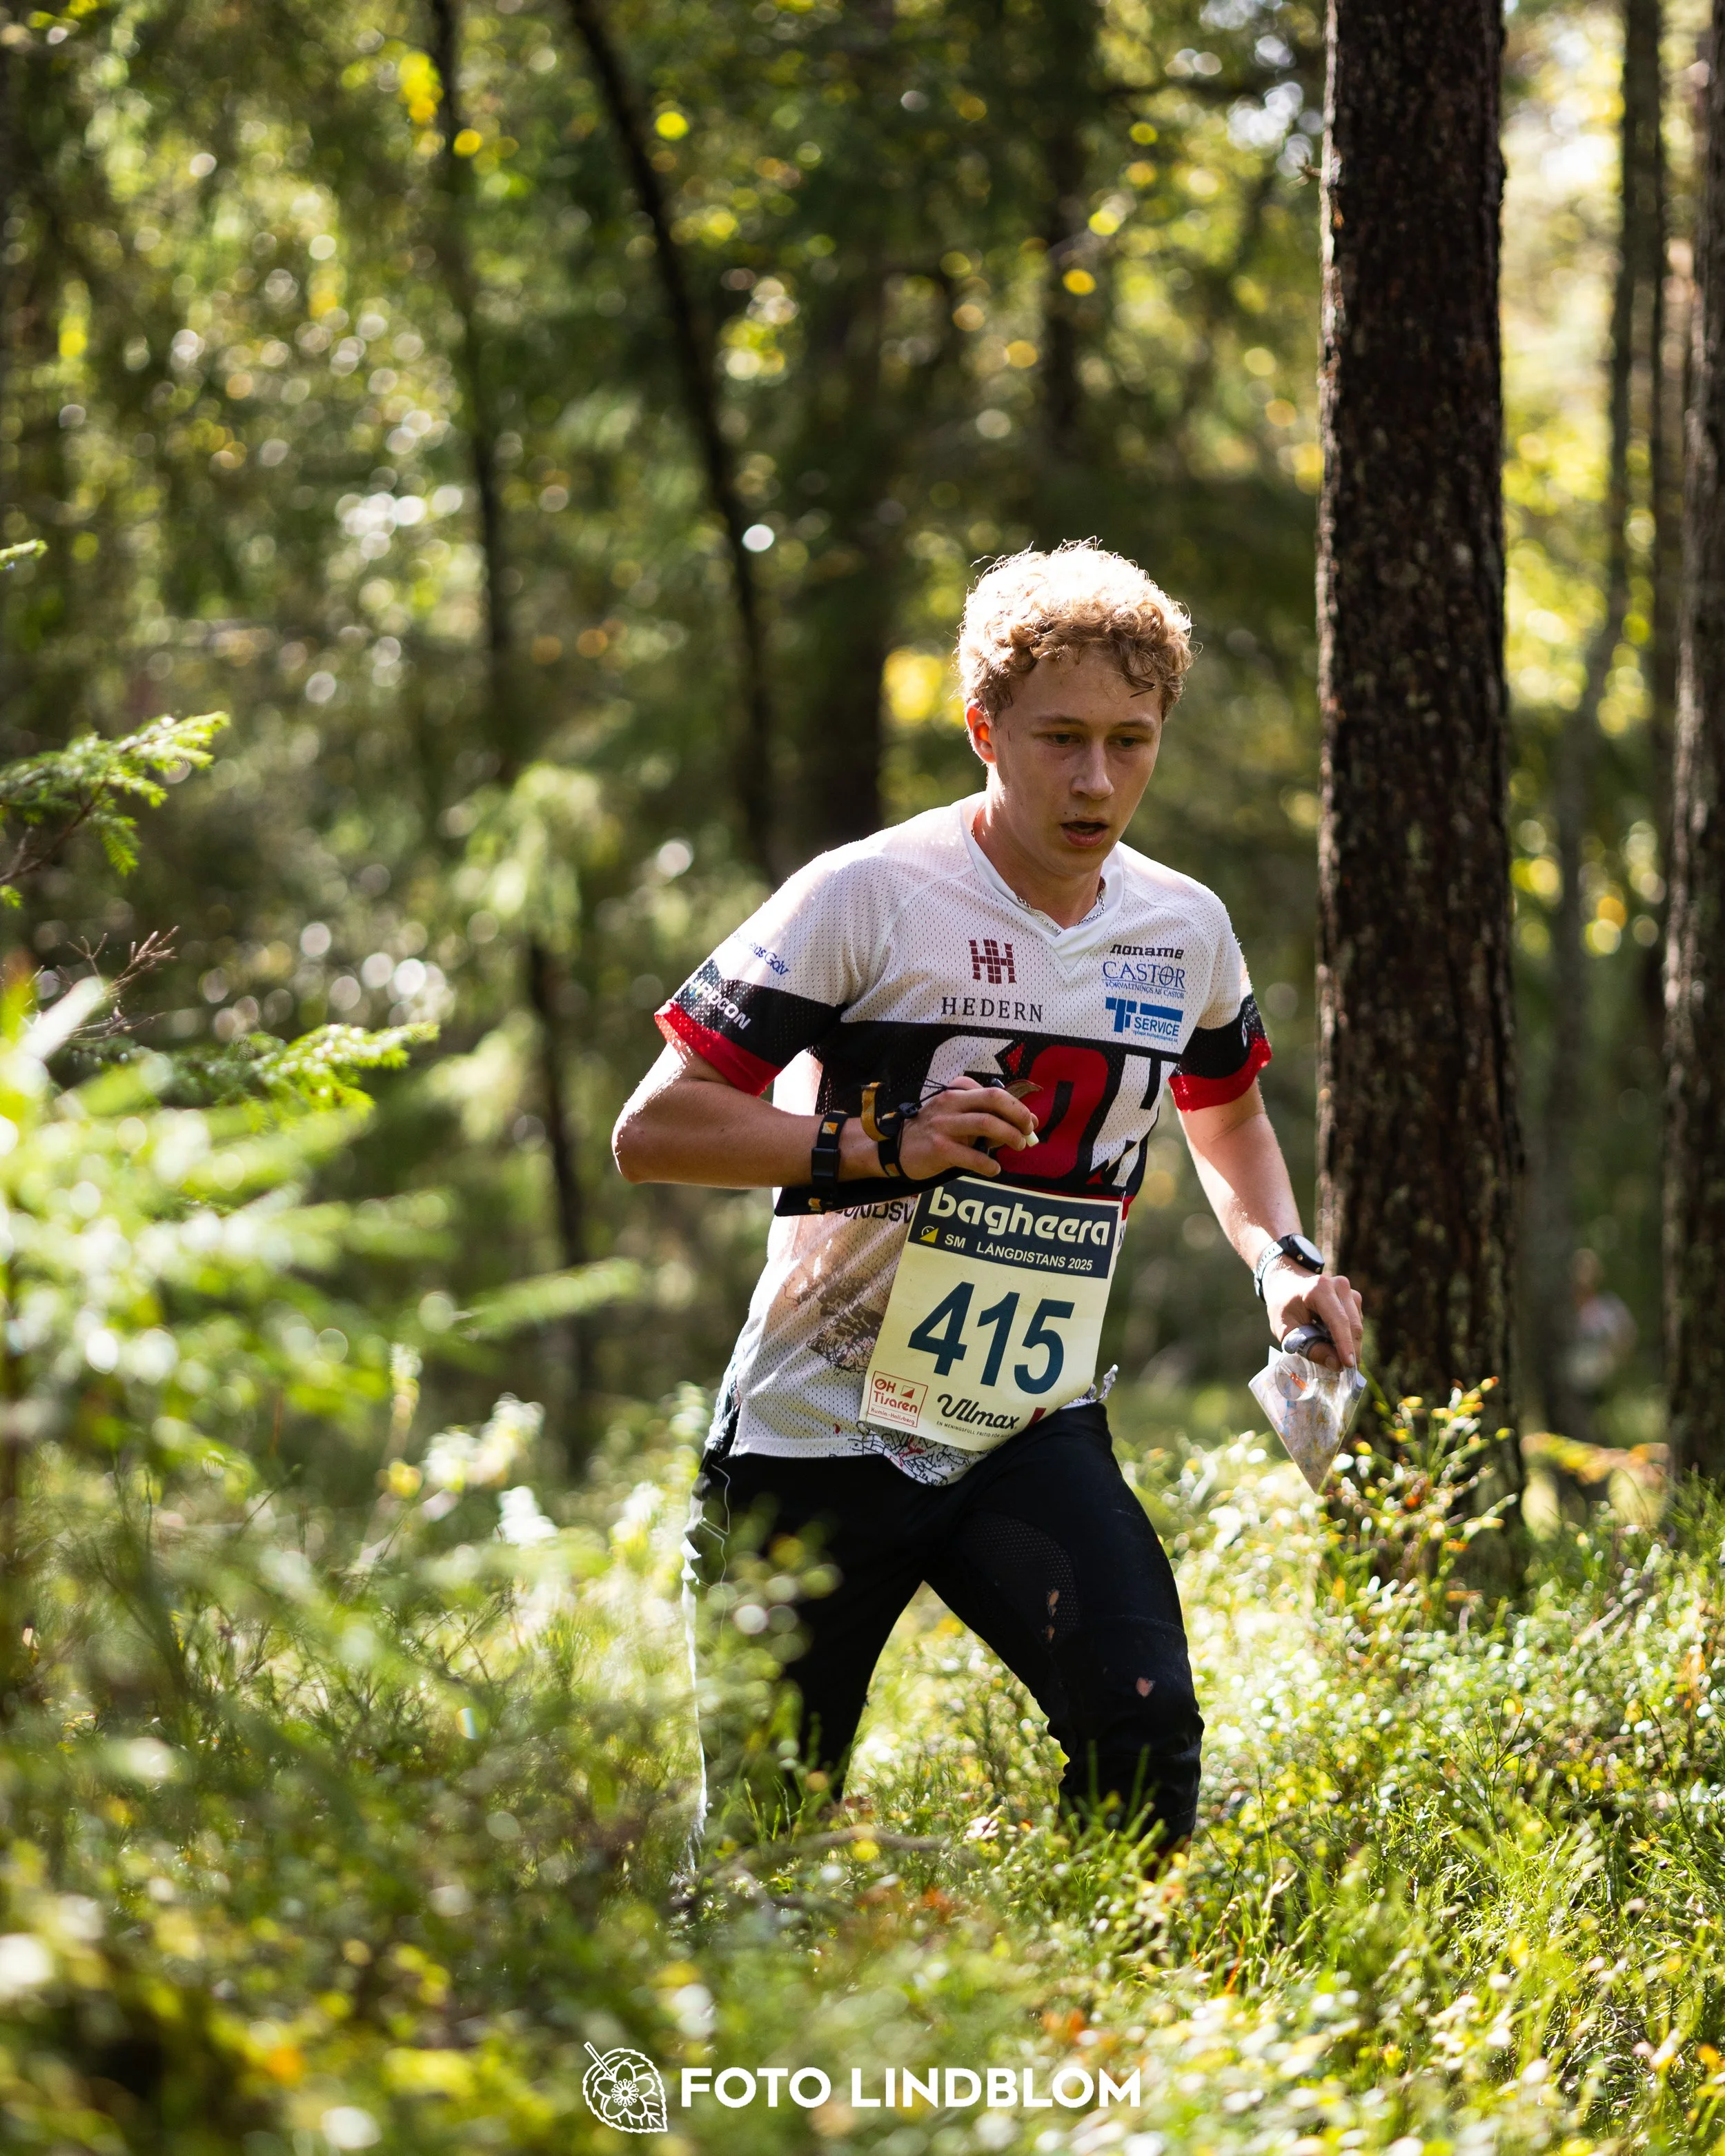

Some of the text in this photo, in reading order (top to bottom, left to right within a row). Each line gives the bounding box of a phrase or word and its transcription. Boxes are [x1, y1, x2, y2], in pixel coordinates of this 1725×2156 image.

[1110, 944, 1184, 959] noname
[1103, 961, 1185, 989] CASTOR
[941, 996, 1043, 1022] HEDERN
[1134, 1016, 1180, 1037] SERVICE
[928, 1186, 1110, 1246] bagheera
[945, 1234, 1093, 1271] SM LÅNGDISTANS 2025
[907, 1281, 1075, 1394] 415
[874, 1390, 918, 1414] Tisaren
[937, 1394, 1020, 1430] Ullmax
[944, 1423, 975, 1435] MENINGSFULL
